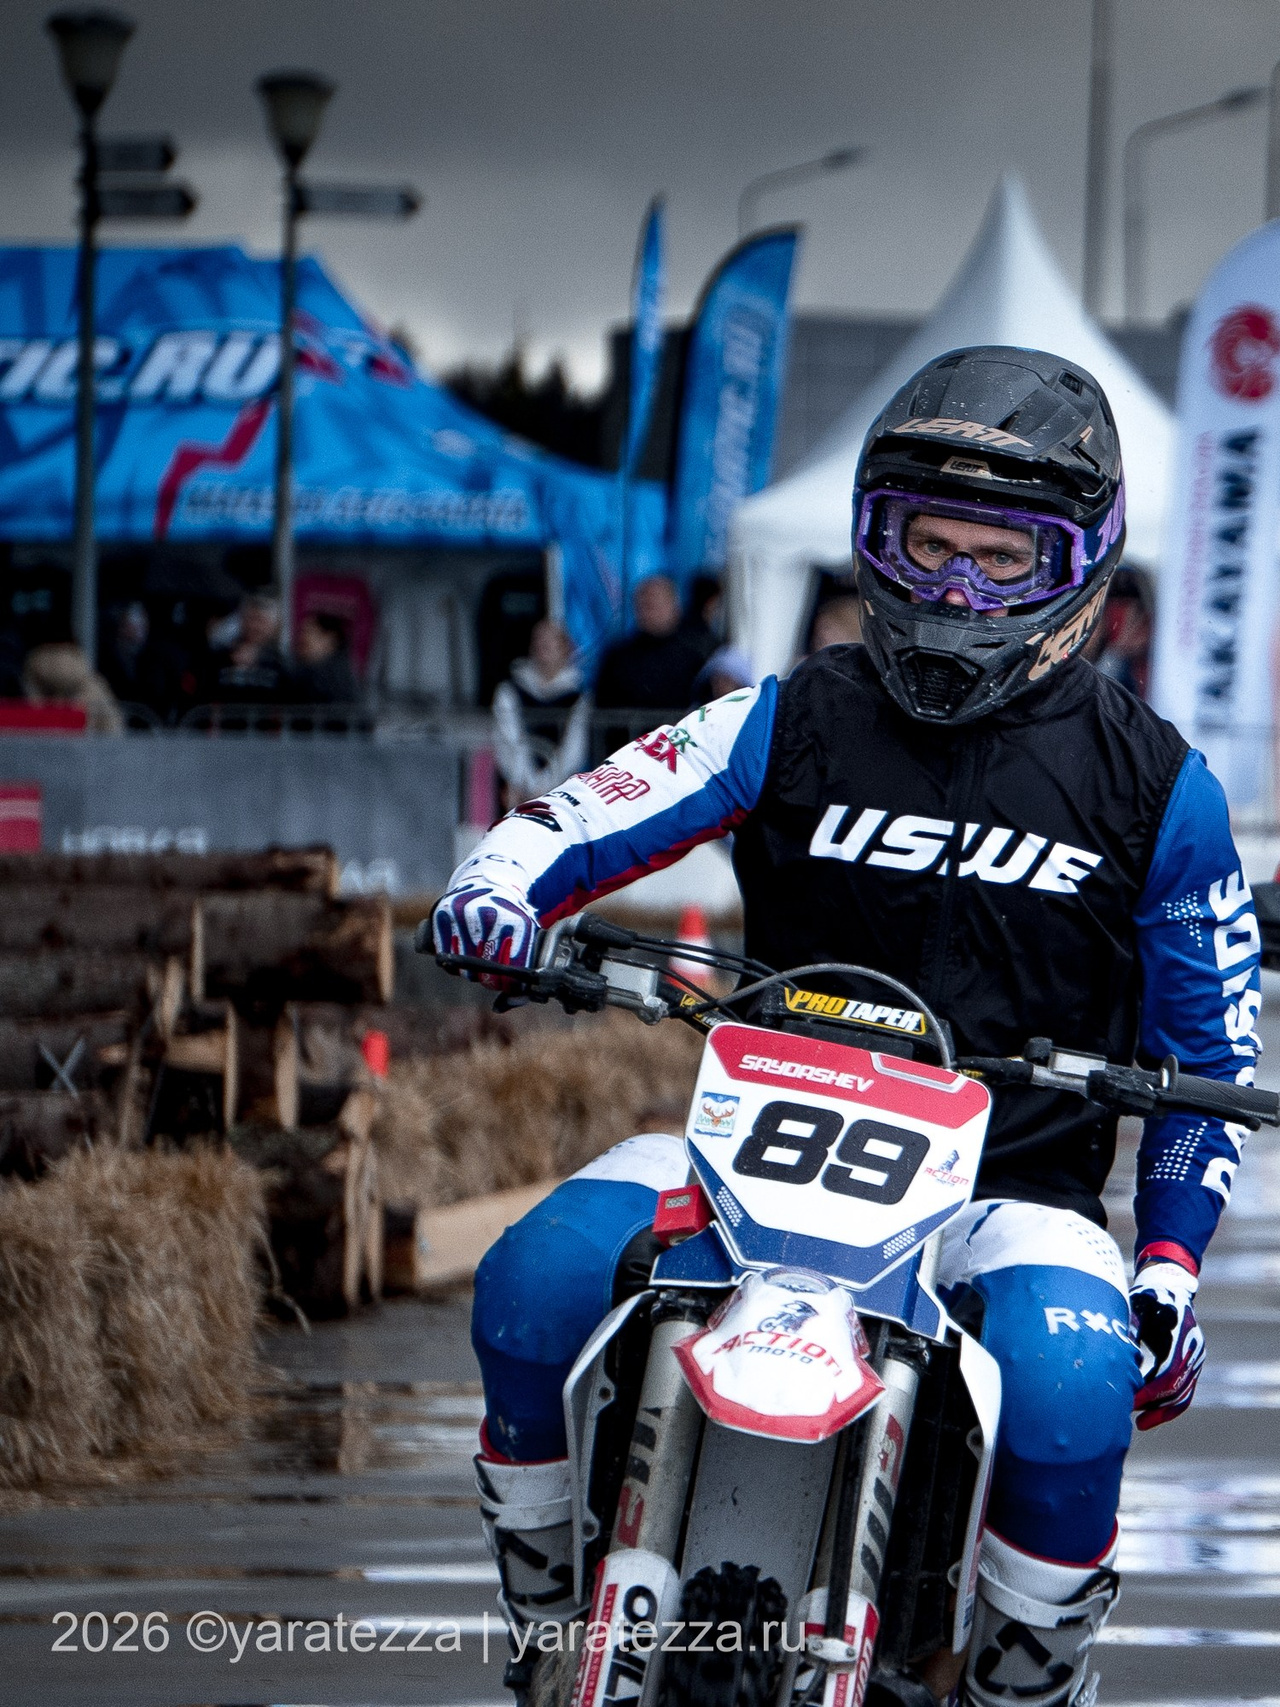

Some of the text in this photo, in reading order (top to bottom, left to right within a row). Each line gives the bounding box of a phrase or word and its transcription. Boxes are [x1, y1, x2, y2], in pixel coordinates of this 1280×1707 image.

[893, 417, 1034, 448] LEATT
[1197, 427, 1260, 738] AKAYAMA
[808, 803, 1104, 894] USWE
[738, 1054, 875, 1093] SAYDASHEV
[731, 1100, 932, 1206] 89
